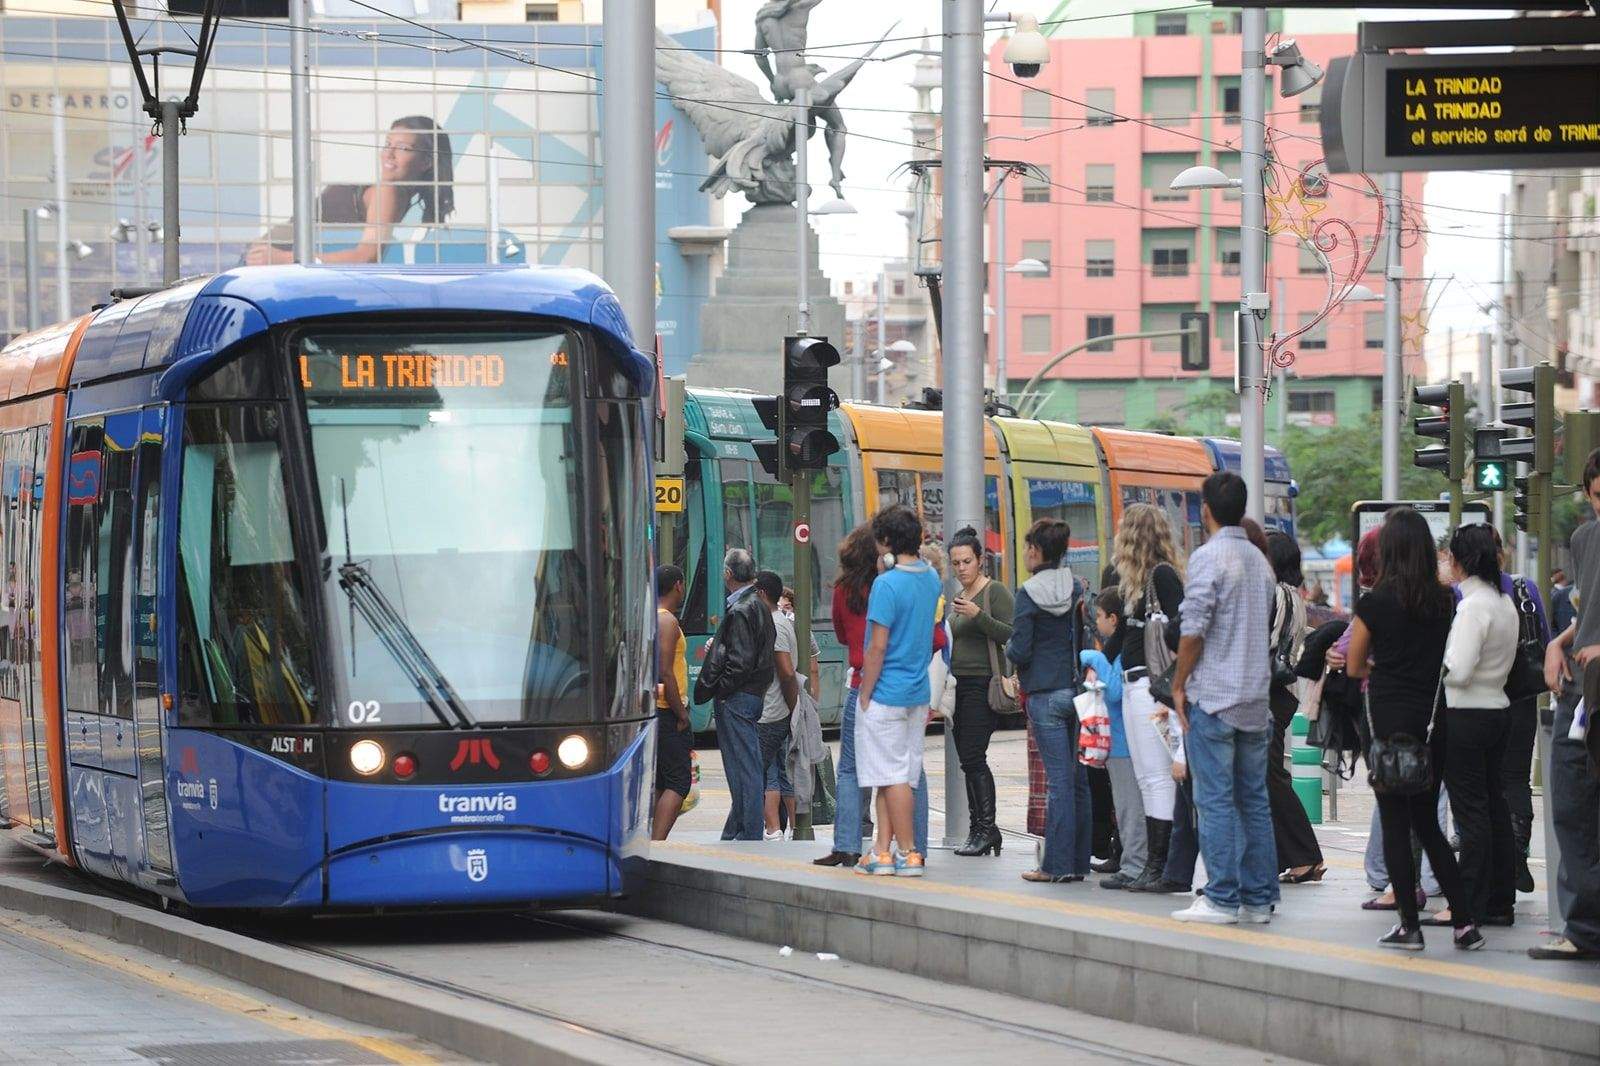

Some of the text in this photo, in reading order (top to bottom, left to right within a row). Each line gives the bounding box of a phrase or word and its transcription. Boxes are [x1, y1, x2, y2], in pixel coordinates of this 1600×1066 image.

[1405, 76, 1502, 96] LA TRINIDAD
[1405, 101, 1502, 121] LA TRINIDAD
[1411, 128, 1425, 146] el
[1431, 127, 1488, 145] servicio
[1534, 125, 1552, 142] de
[341, 354, 375, 388] LA
[382, 353, 504, 388] TRINIDAD
[348, 700, 382, 724] 02
[270, 736, 314, 754] ALSTOM
[438, 792, 518, 813] tranvía
